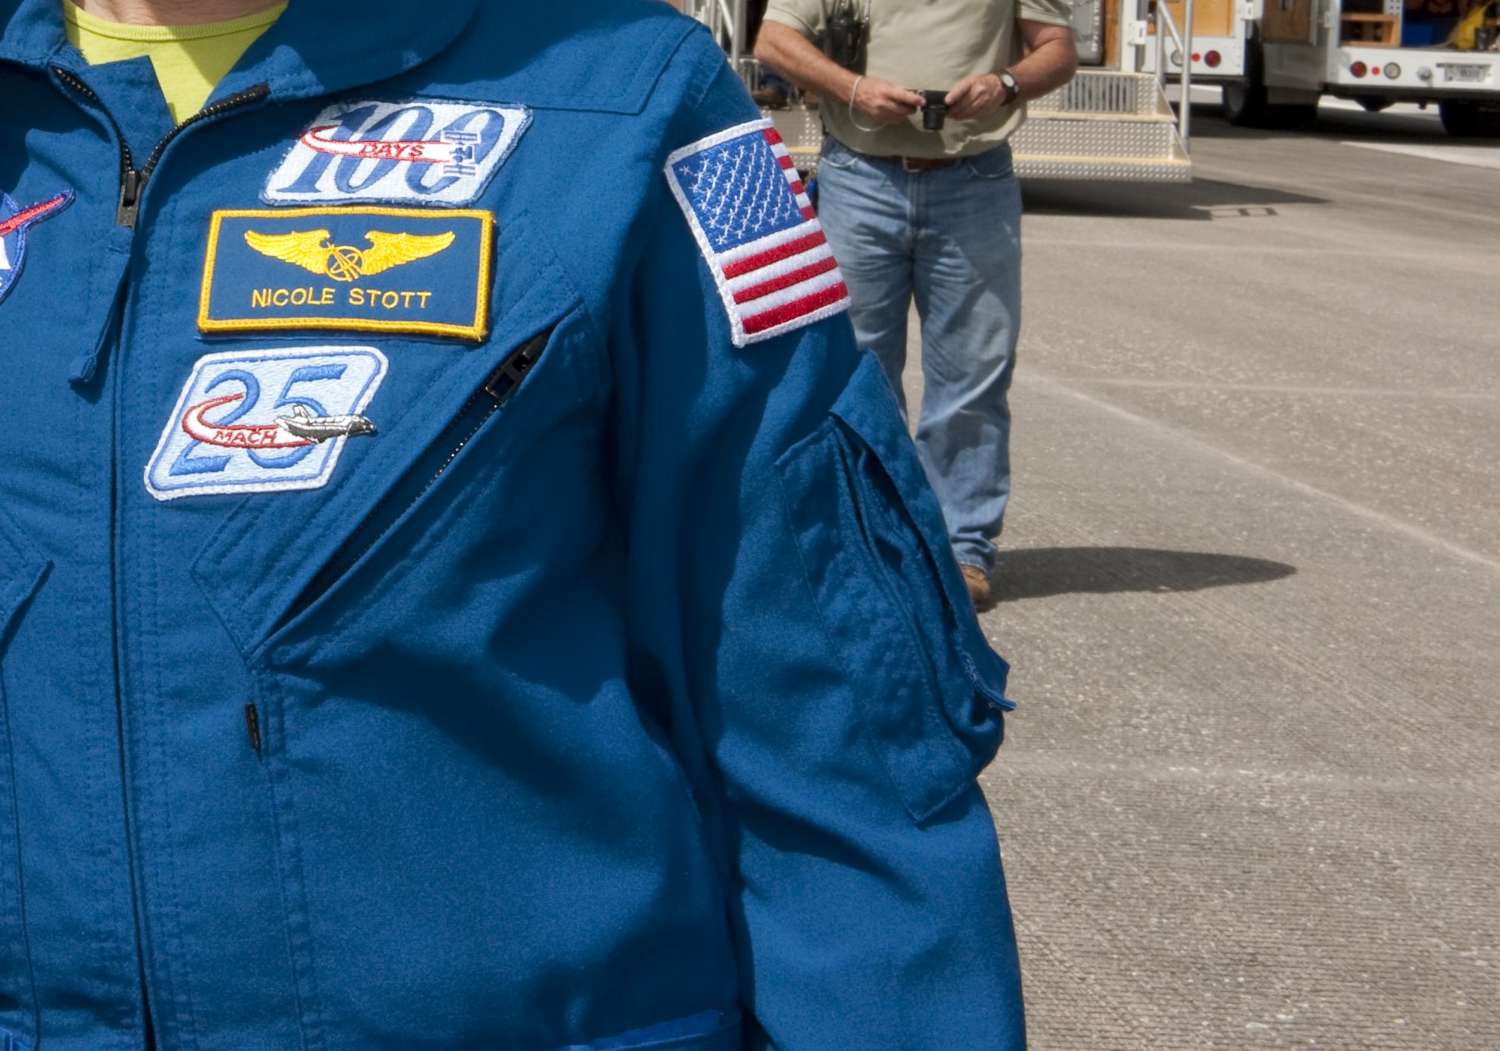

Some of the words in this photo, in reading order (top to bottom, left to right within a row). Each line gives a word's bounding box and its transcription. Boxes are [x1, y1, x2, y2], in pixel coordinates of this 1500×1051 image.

[276, 104, 505, 195] 100
[358, 143, 424, 159] DAYS
[251, 286, 336, 308] NICOLE
[348, 288, 432, 309] STOTT
[169, 363, 348, 476] 25
[212, 428, 278, 446] MACH
